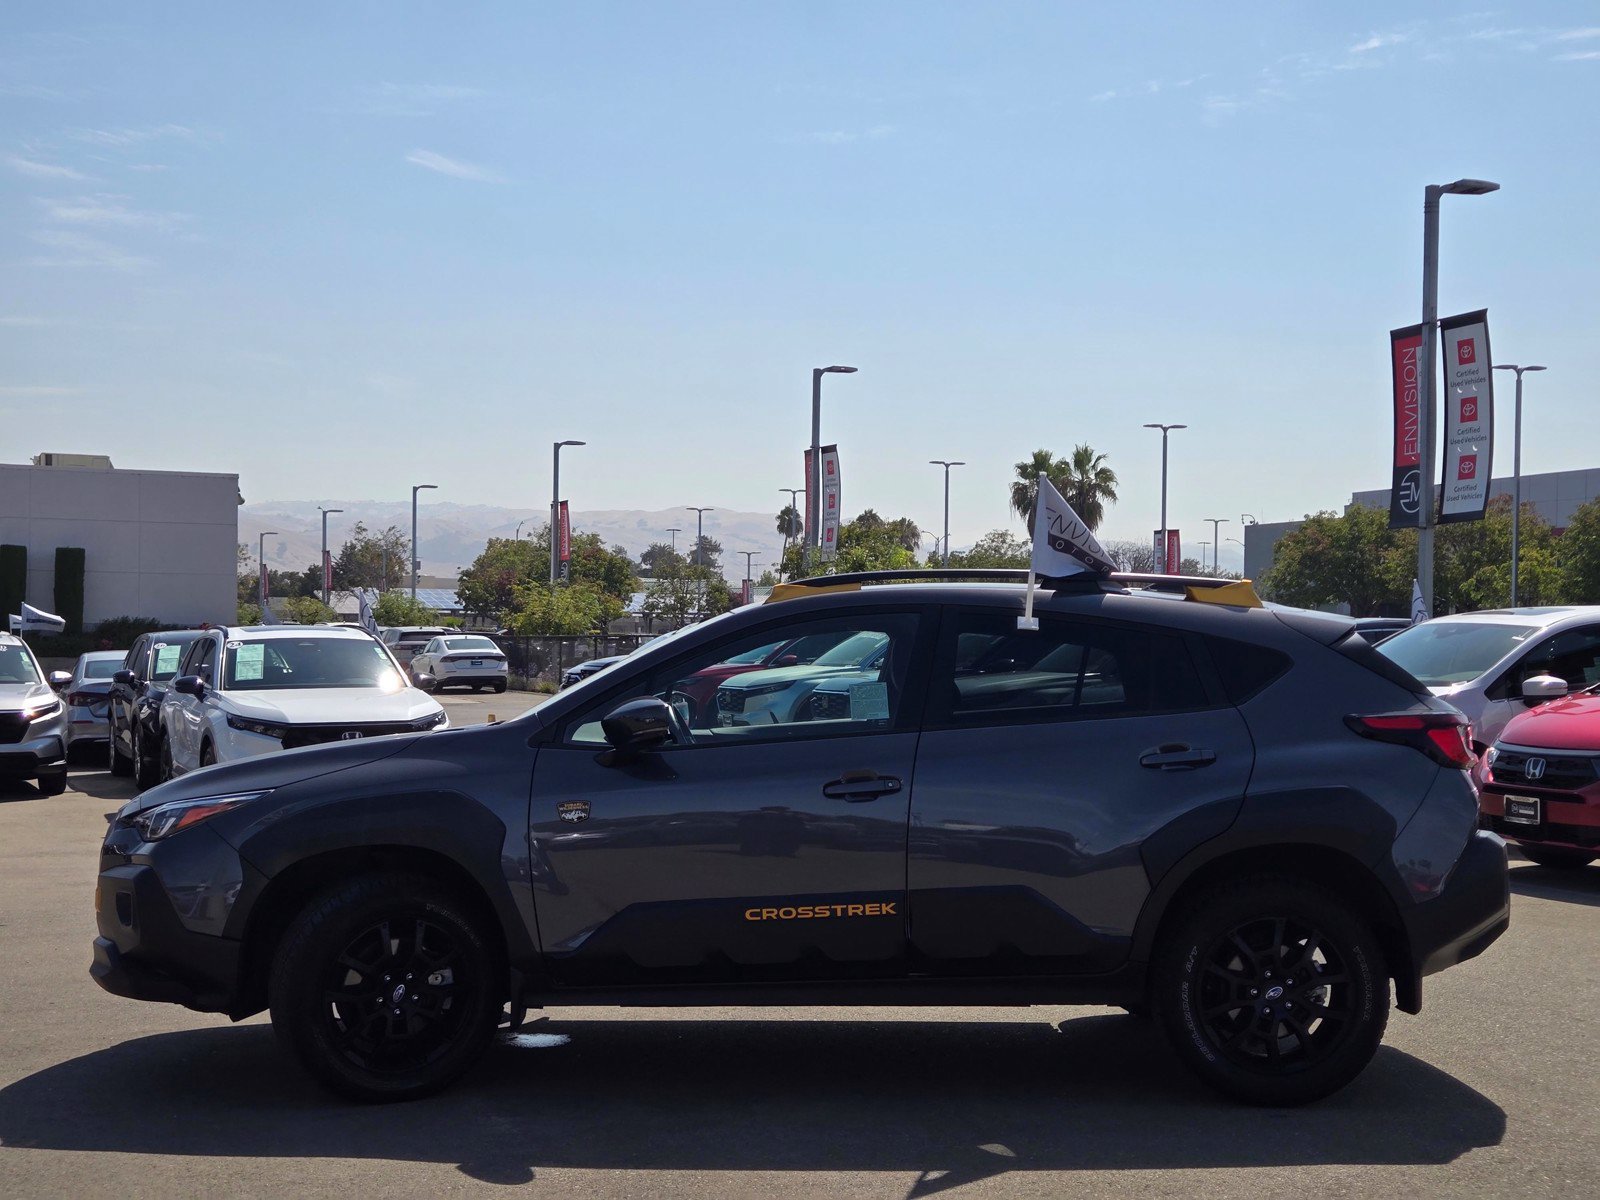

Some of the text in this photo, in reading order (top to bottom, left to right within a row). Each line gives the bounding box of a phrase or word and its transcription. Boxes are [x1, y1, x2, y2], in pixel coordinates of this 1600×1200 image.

[1456, 368, 1479, 378] Certified
[1450, 377, 1486, 388] Used Vehicles
[1403, 346, 1417, 456] ENVISION
[1457, 426, 1480, 436] Certified
[1450, 434, 1487, 445] Used Vehicles
[1454, 484, 1477, 494] Certified
[1446, 492, 1483, 502] Used Vehicles
[745, 902, 897, 921] CROSSTREK
